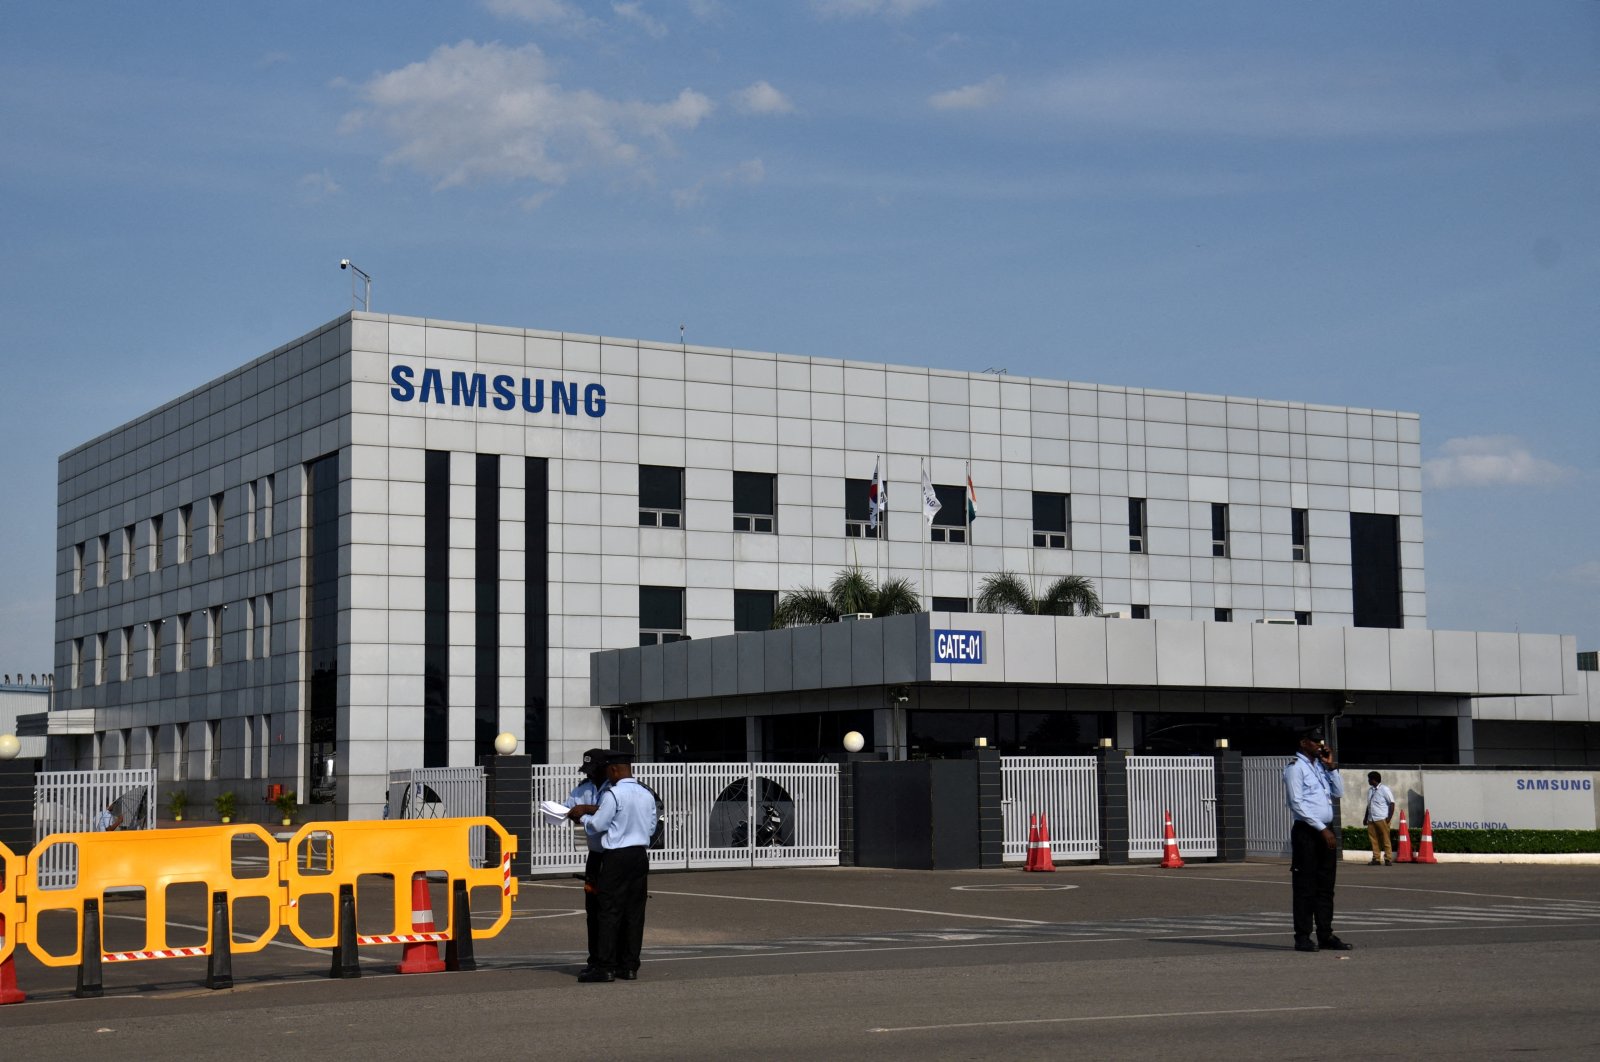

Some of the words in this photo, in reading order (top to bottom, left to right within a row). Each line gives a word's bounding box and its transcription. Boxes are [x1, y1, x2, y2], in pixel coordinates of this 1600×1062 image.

[390, 364, 607, 418] SAMSUNG
[937, 633, 980, 660] GATE-01
[1516, 778, 1592, 791] SAMSUNG
[1431, 821, 1479, 830] SAMSUNG
[1481, 822, 1508, 830] INDIA
